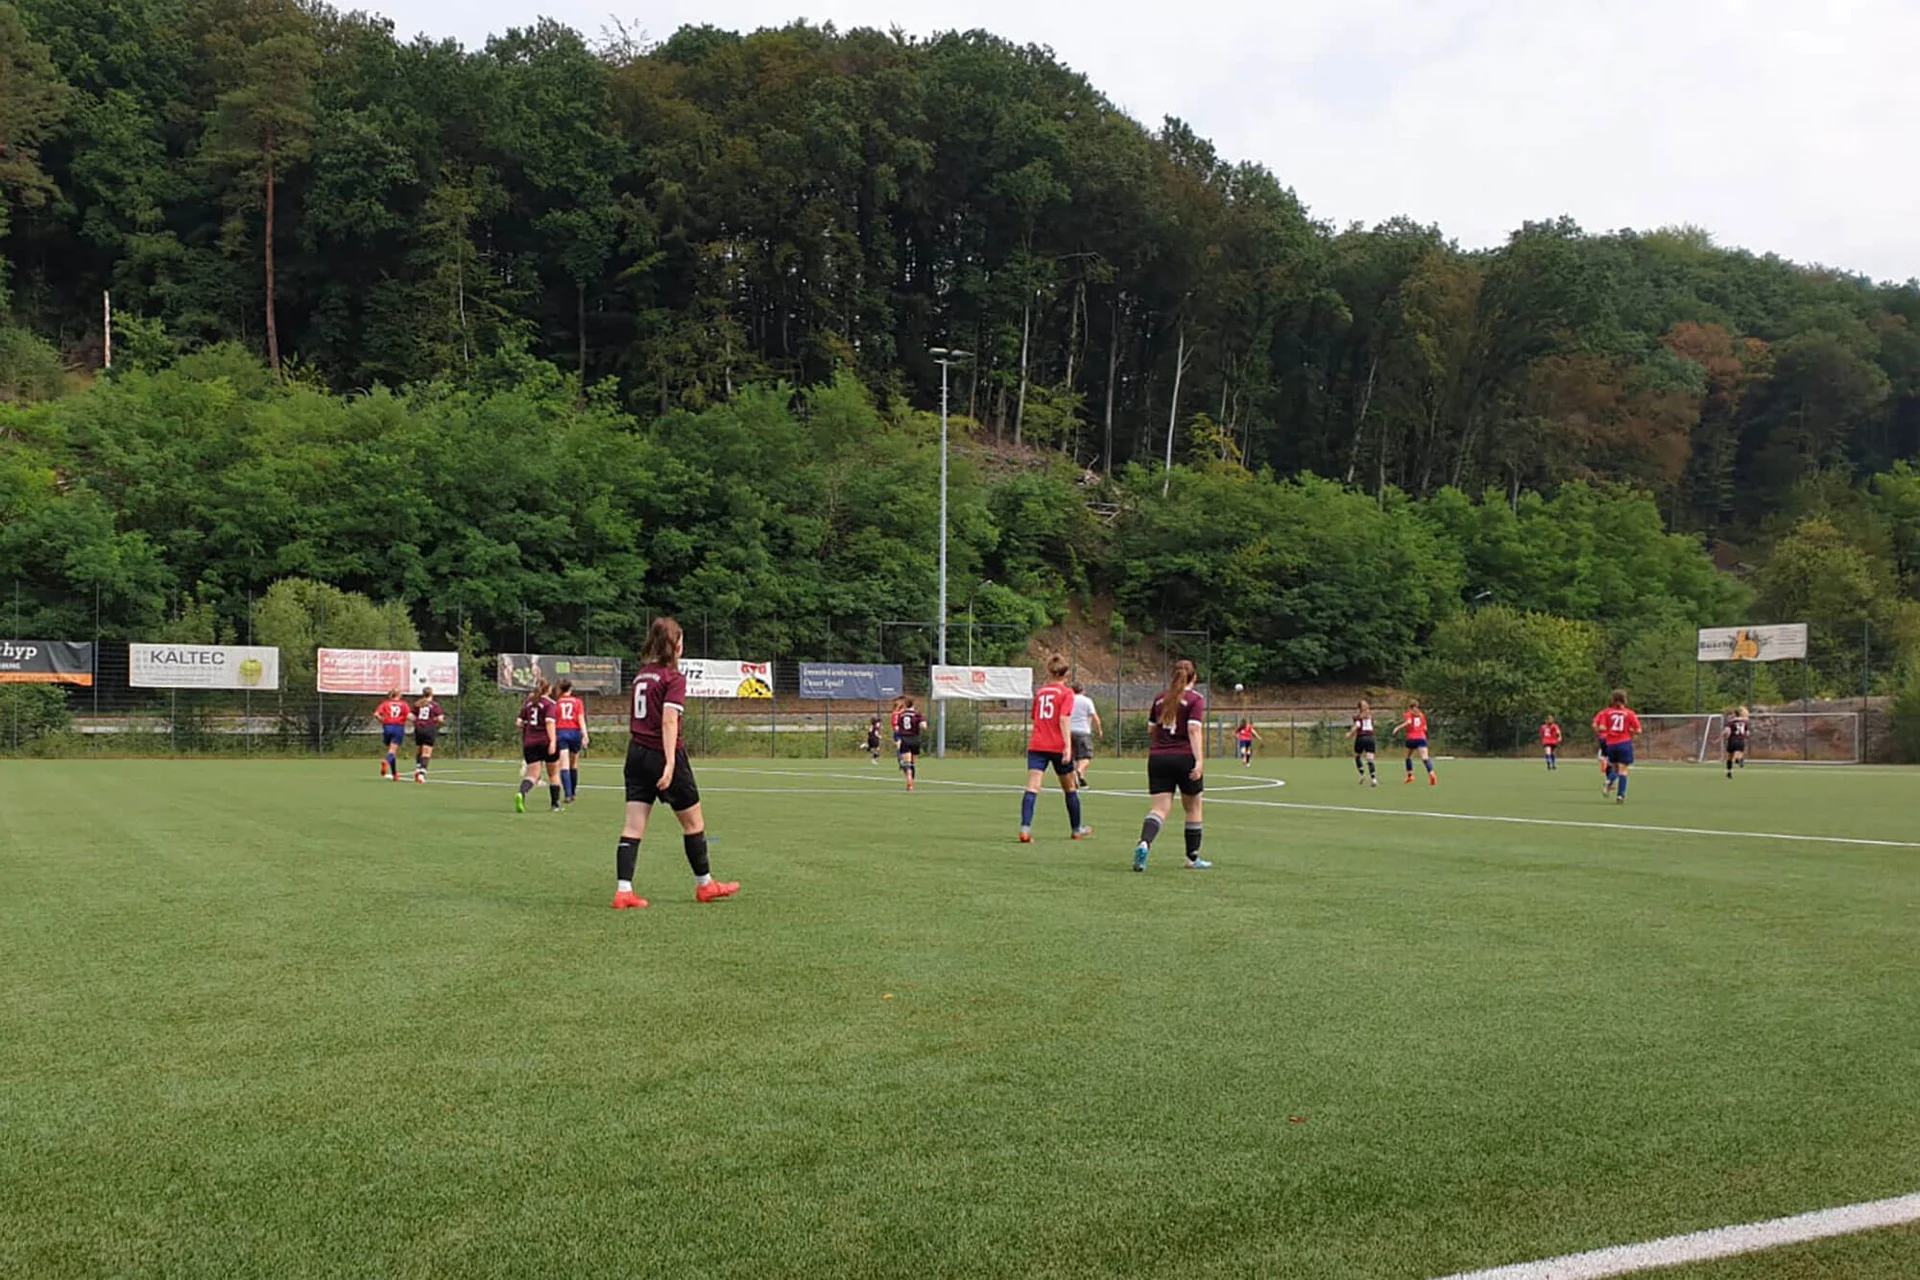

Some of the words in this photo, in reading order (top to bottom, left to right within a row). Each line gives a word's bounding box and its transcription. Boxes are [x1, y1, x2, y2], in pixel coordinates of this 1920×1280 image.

[0, 642, 38, 660] hyp
[634, 682, 648, 718] 6
[1038, 694, 1054, 719] 15
[530, 708, 538, 725] 3
[561, 703, 573, 719] 12
[1611, 714, 1624, 731] 21
